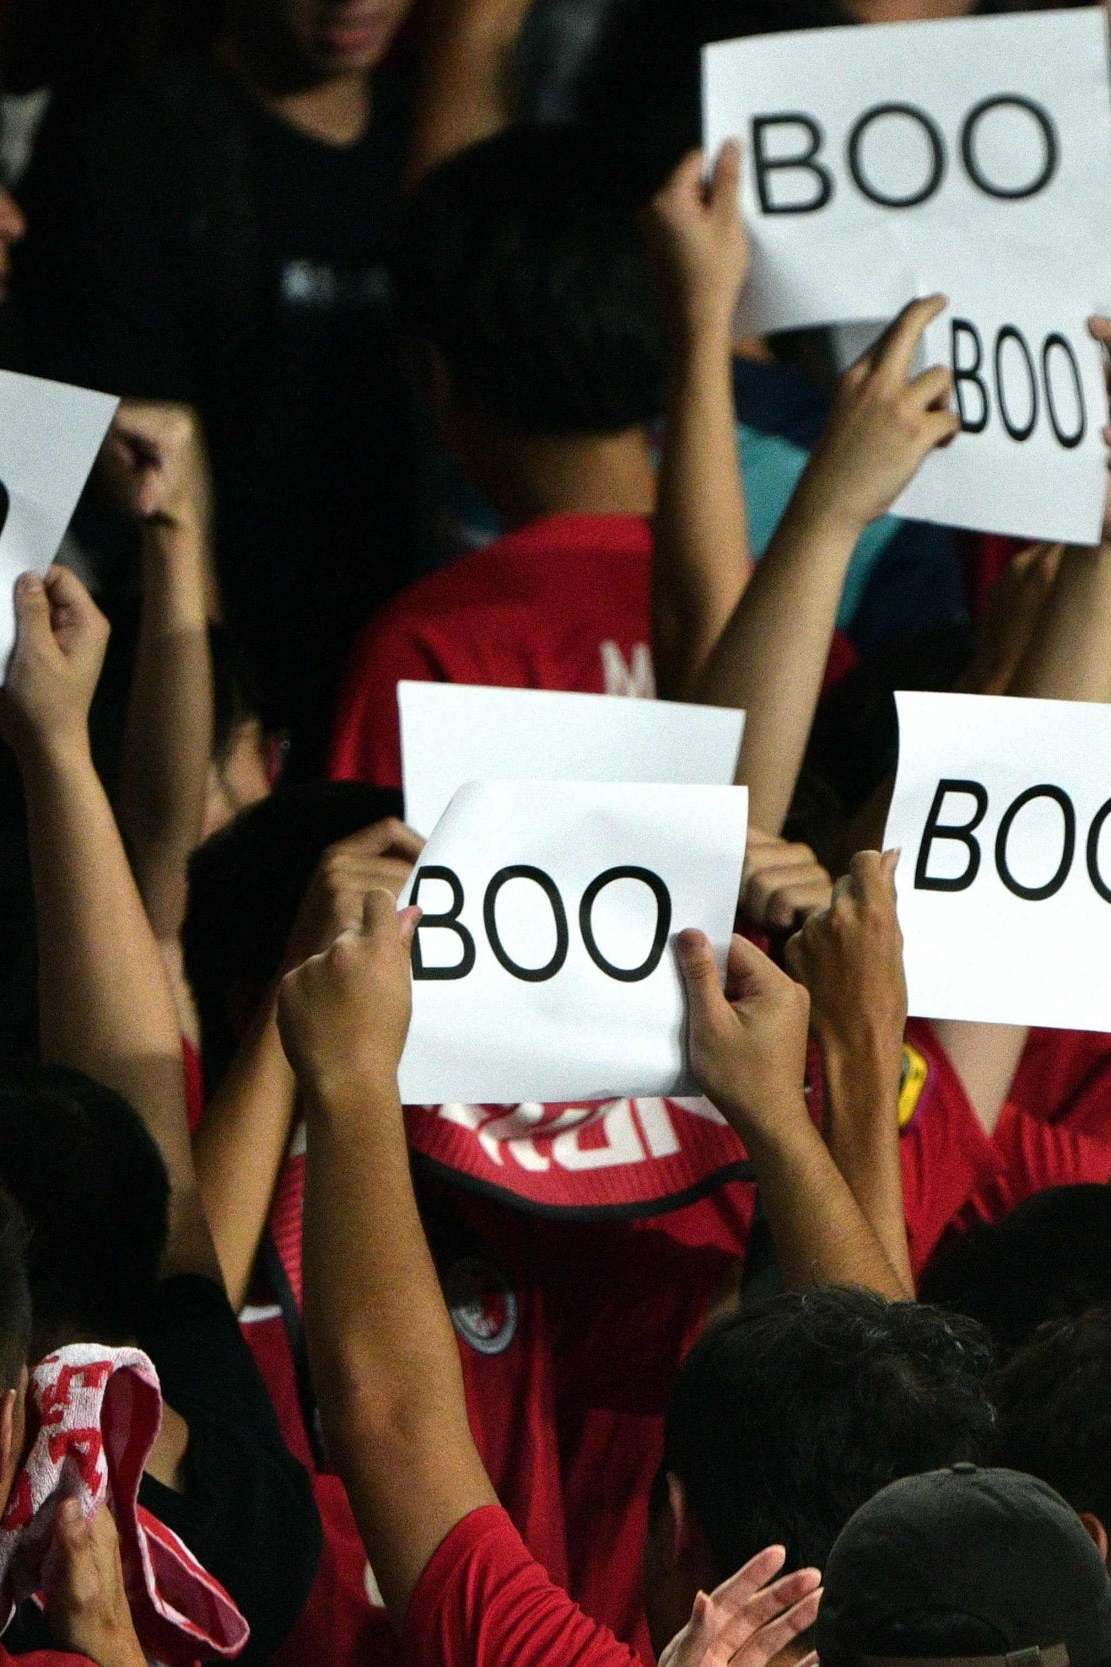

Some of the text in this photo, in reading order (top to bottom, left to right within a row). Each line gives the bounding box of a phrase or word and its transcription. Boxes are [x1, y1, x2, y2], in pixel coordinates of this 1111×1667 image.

[750, 93, 1059, 216] BOO
[950, 317, 1086, 450] BOO
[411, 863, 673, 983] BOO
